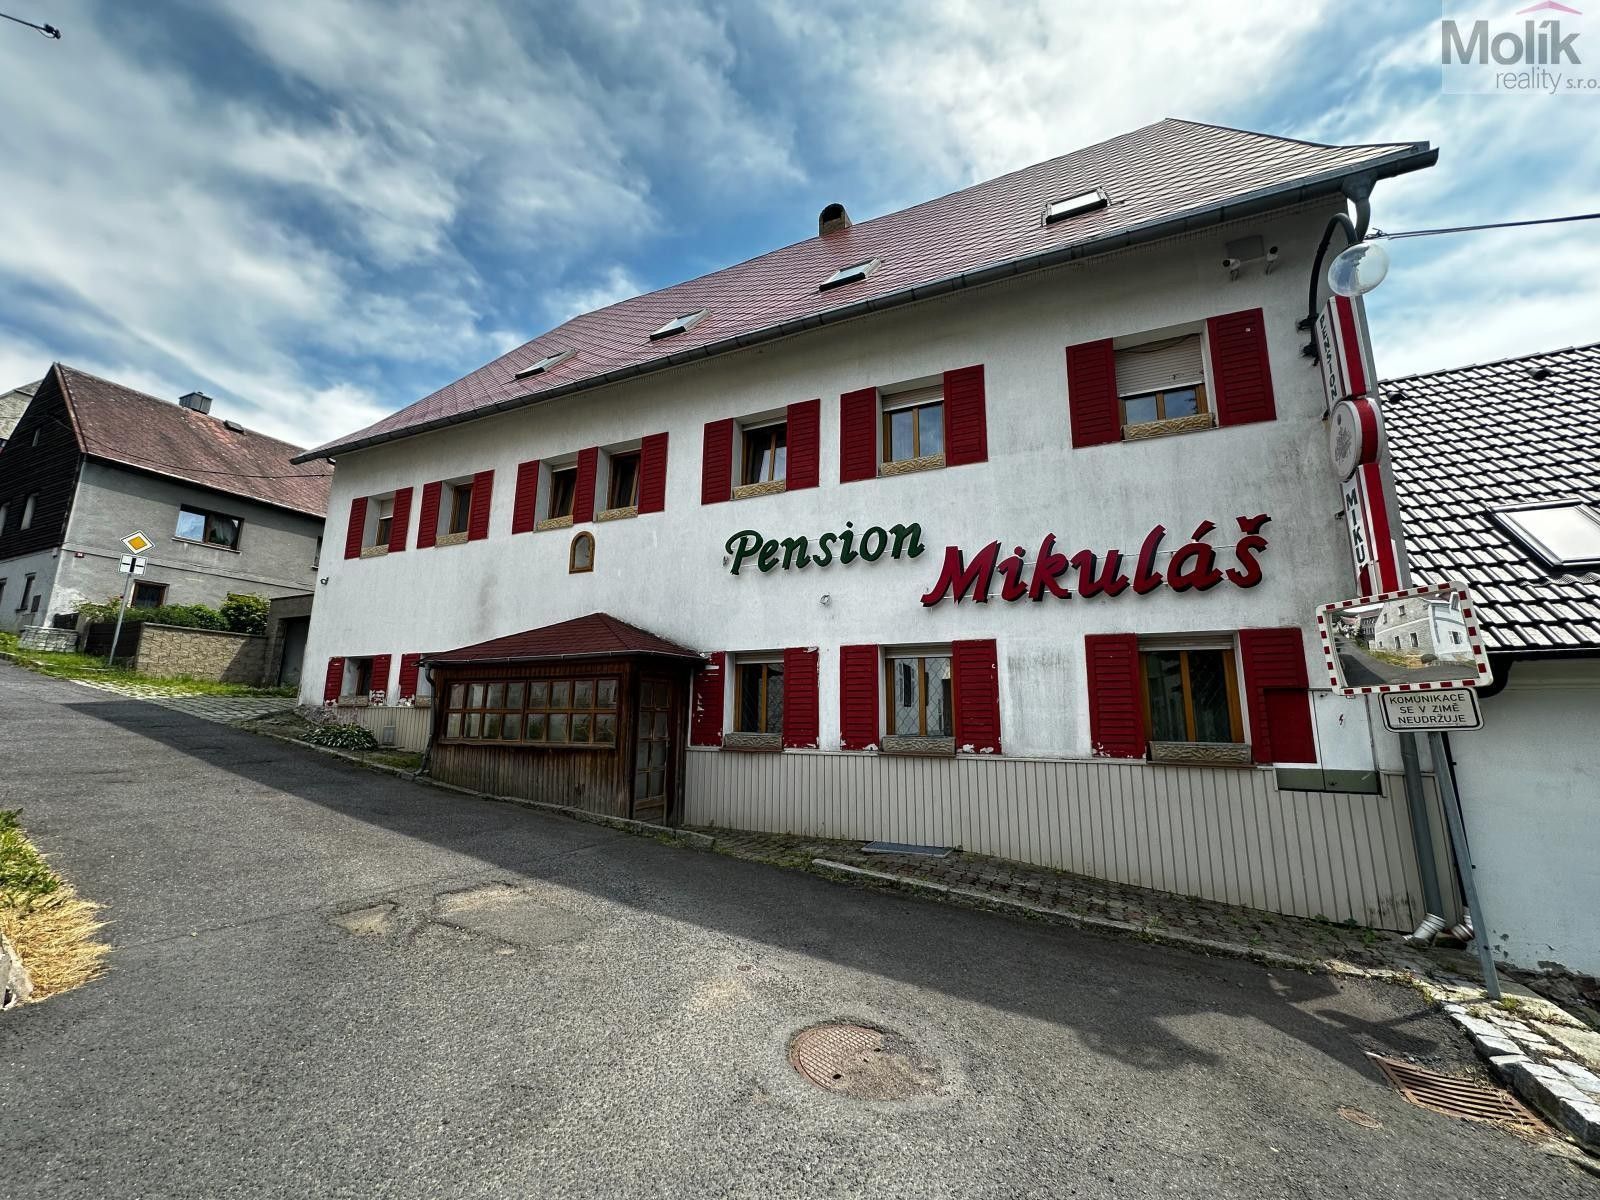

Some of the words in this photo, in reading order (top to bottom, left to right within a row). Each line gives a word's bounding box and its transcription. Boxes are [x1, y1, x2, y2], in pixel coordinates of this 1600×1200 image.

[1320, 314, 1338, 401] PENSION
[724, 521, 924, 576] Pension
[920, 513, 1272, 608] Mikuláš
[1389, 693, 1466, 705] KOMUNIKACE
[1400, 706, 1414, 714] SE
[1418, 705, 1426, 713] V
[1432, 702, 1460, 713] ZIMĚ
[1398, 713, 1466, 724] NEUDRŽUJE
